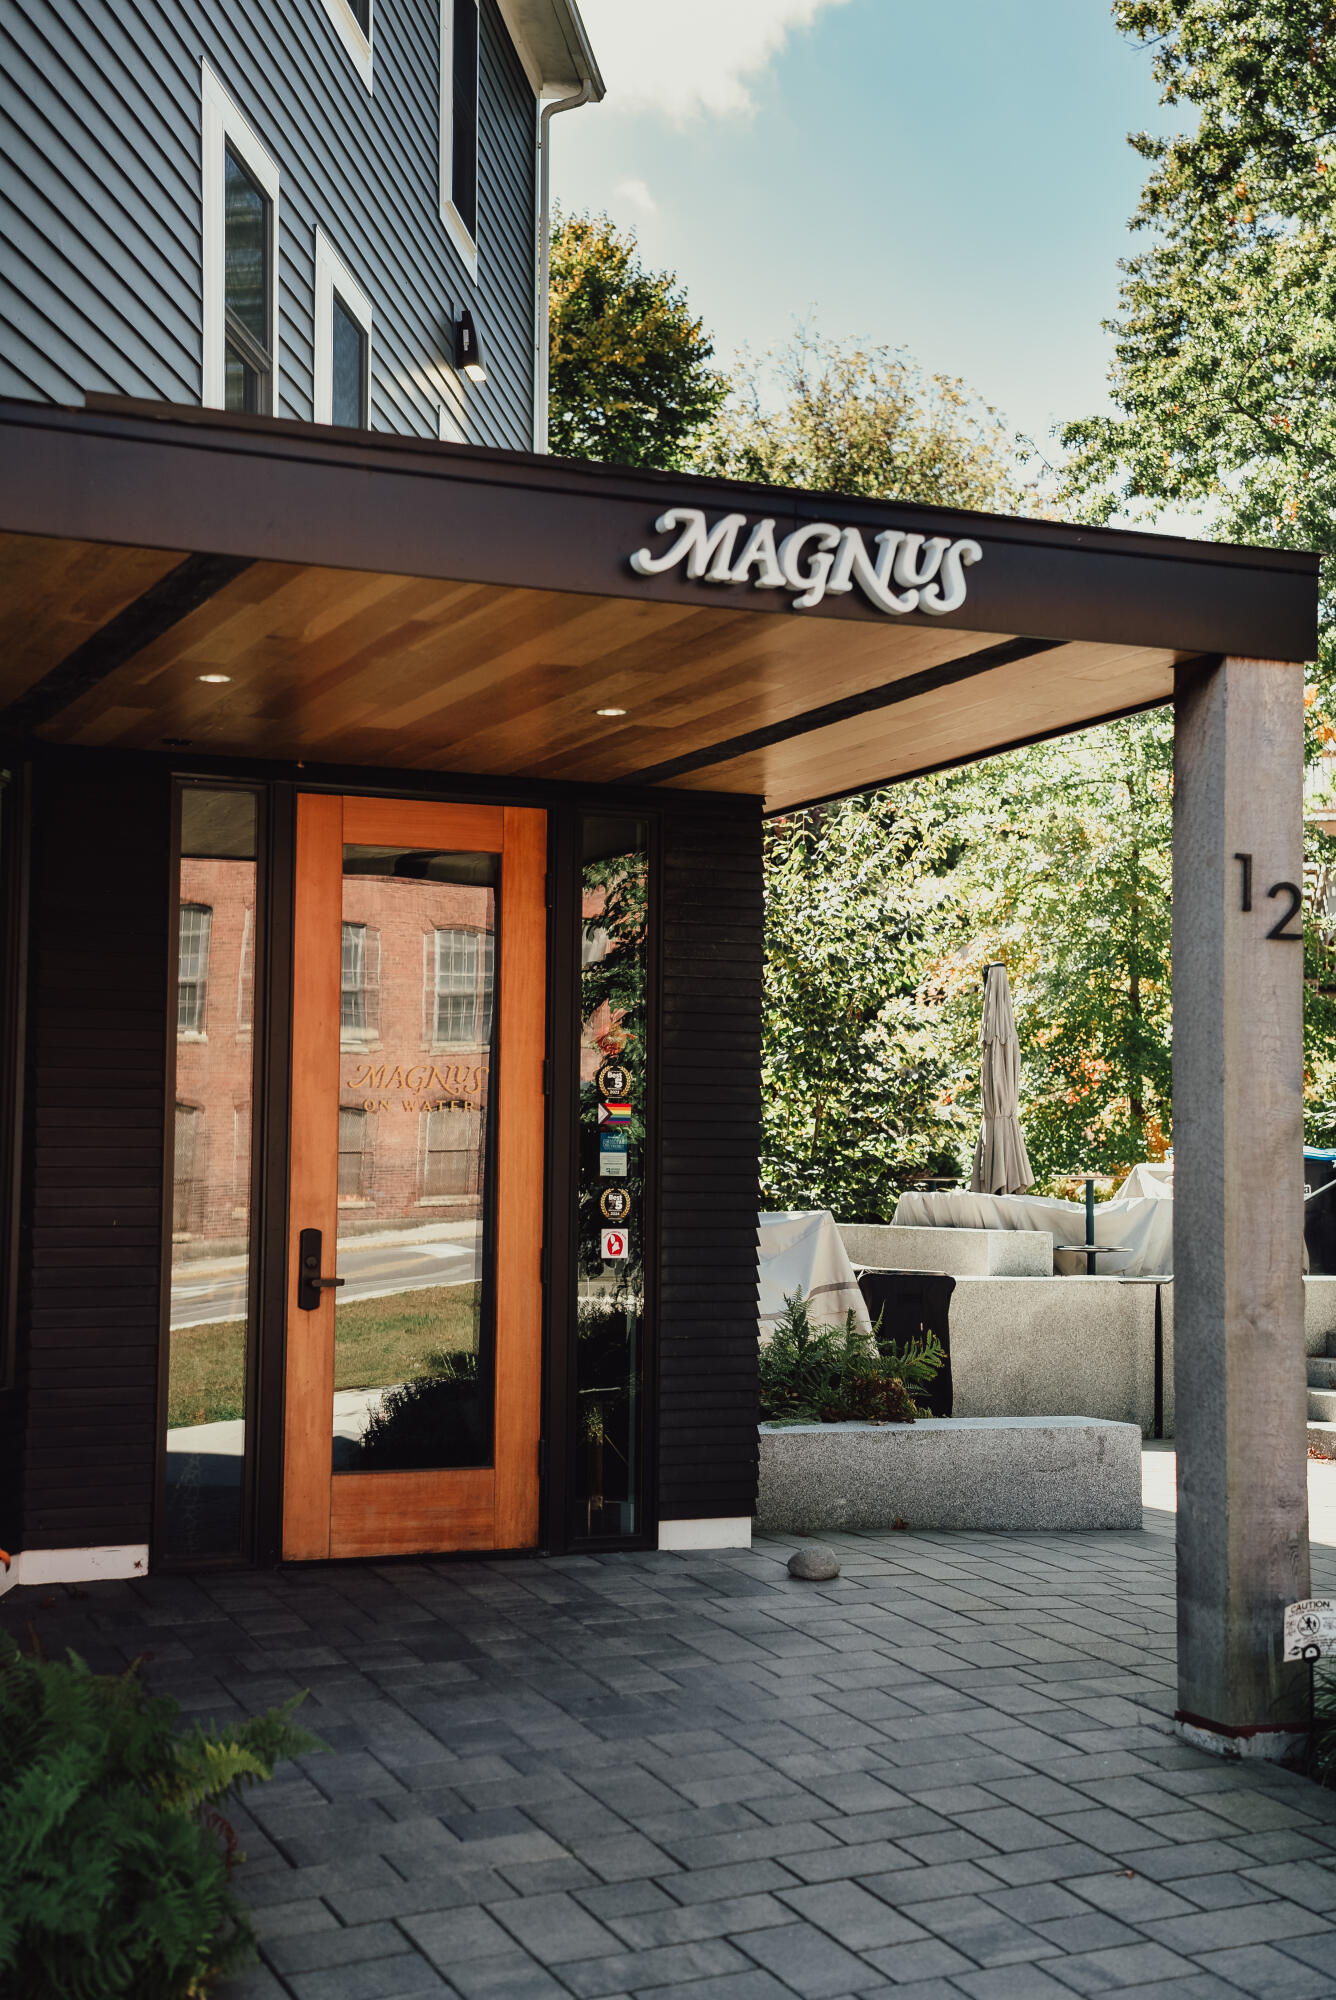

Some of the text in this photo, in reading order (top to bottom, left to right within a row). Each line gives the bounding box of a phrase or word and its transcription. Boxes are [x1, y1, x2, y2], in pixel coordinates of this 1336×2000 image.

[630, 508, 983, 616] MAGNUS
[1234, 853, 1303, 941] 12
[347, 1063, 489, 1096] MAGNUS
[607, 1071, 623, 1079] Best
[364, 1099, 474, 1113] ON WATER
[1290, 1600, 1330, 1613] CAUTION
